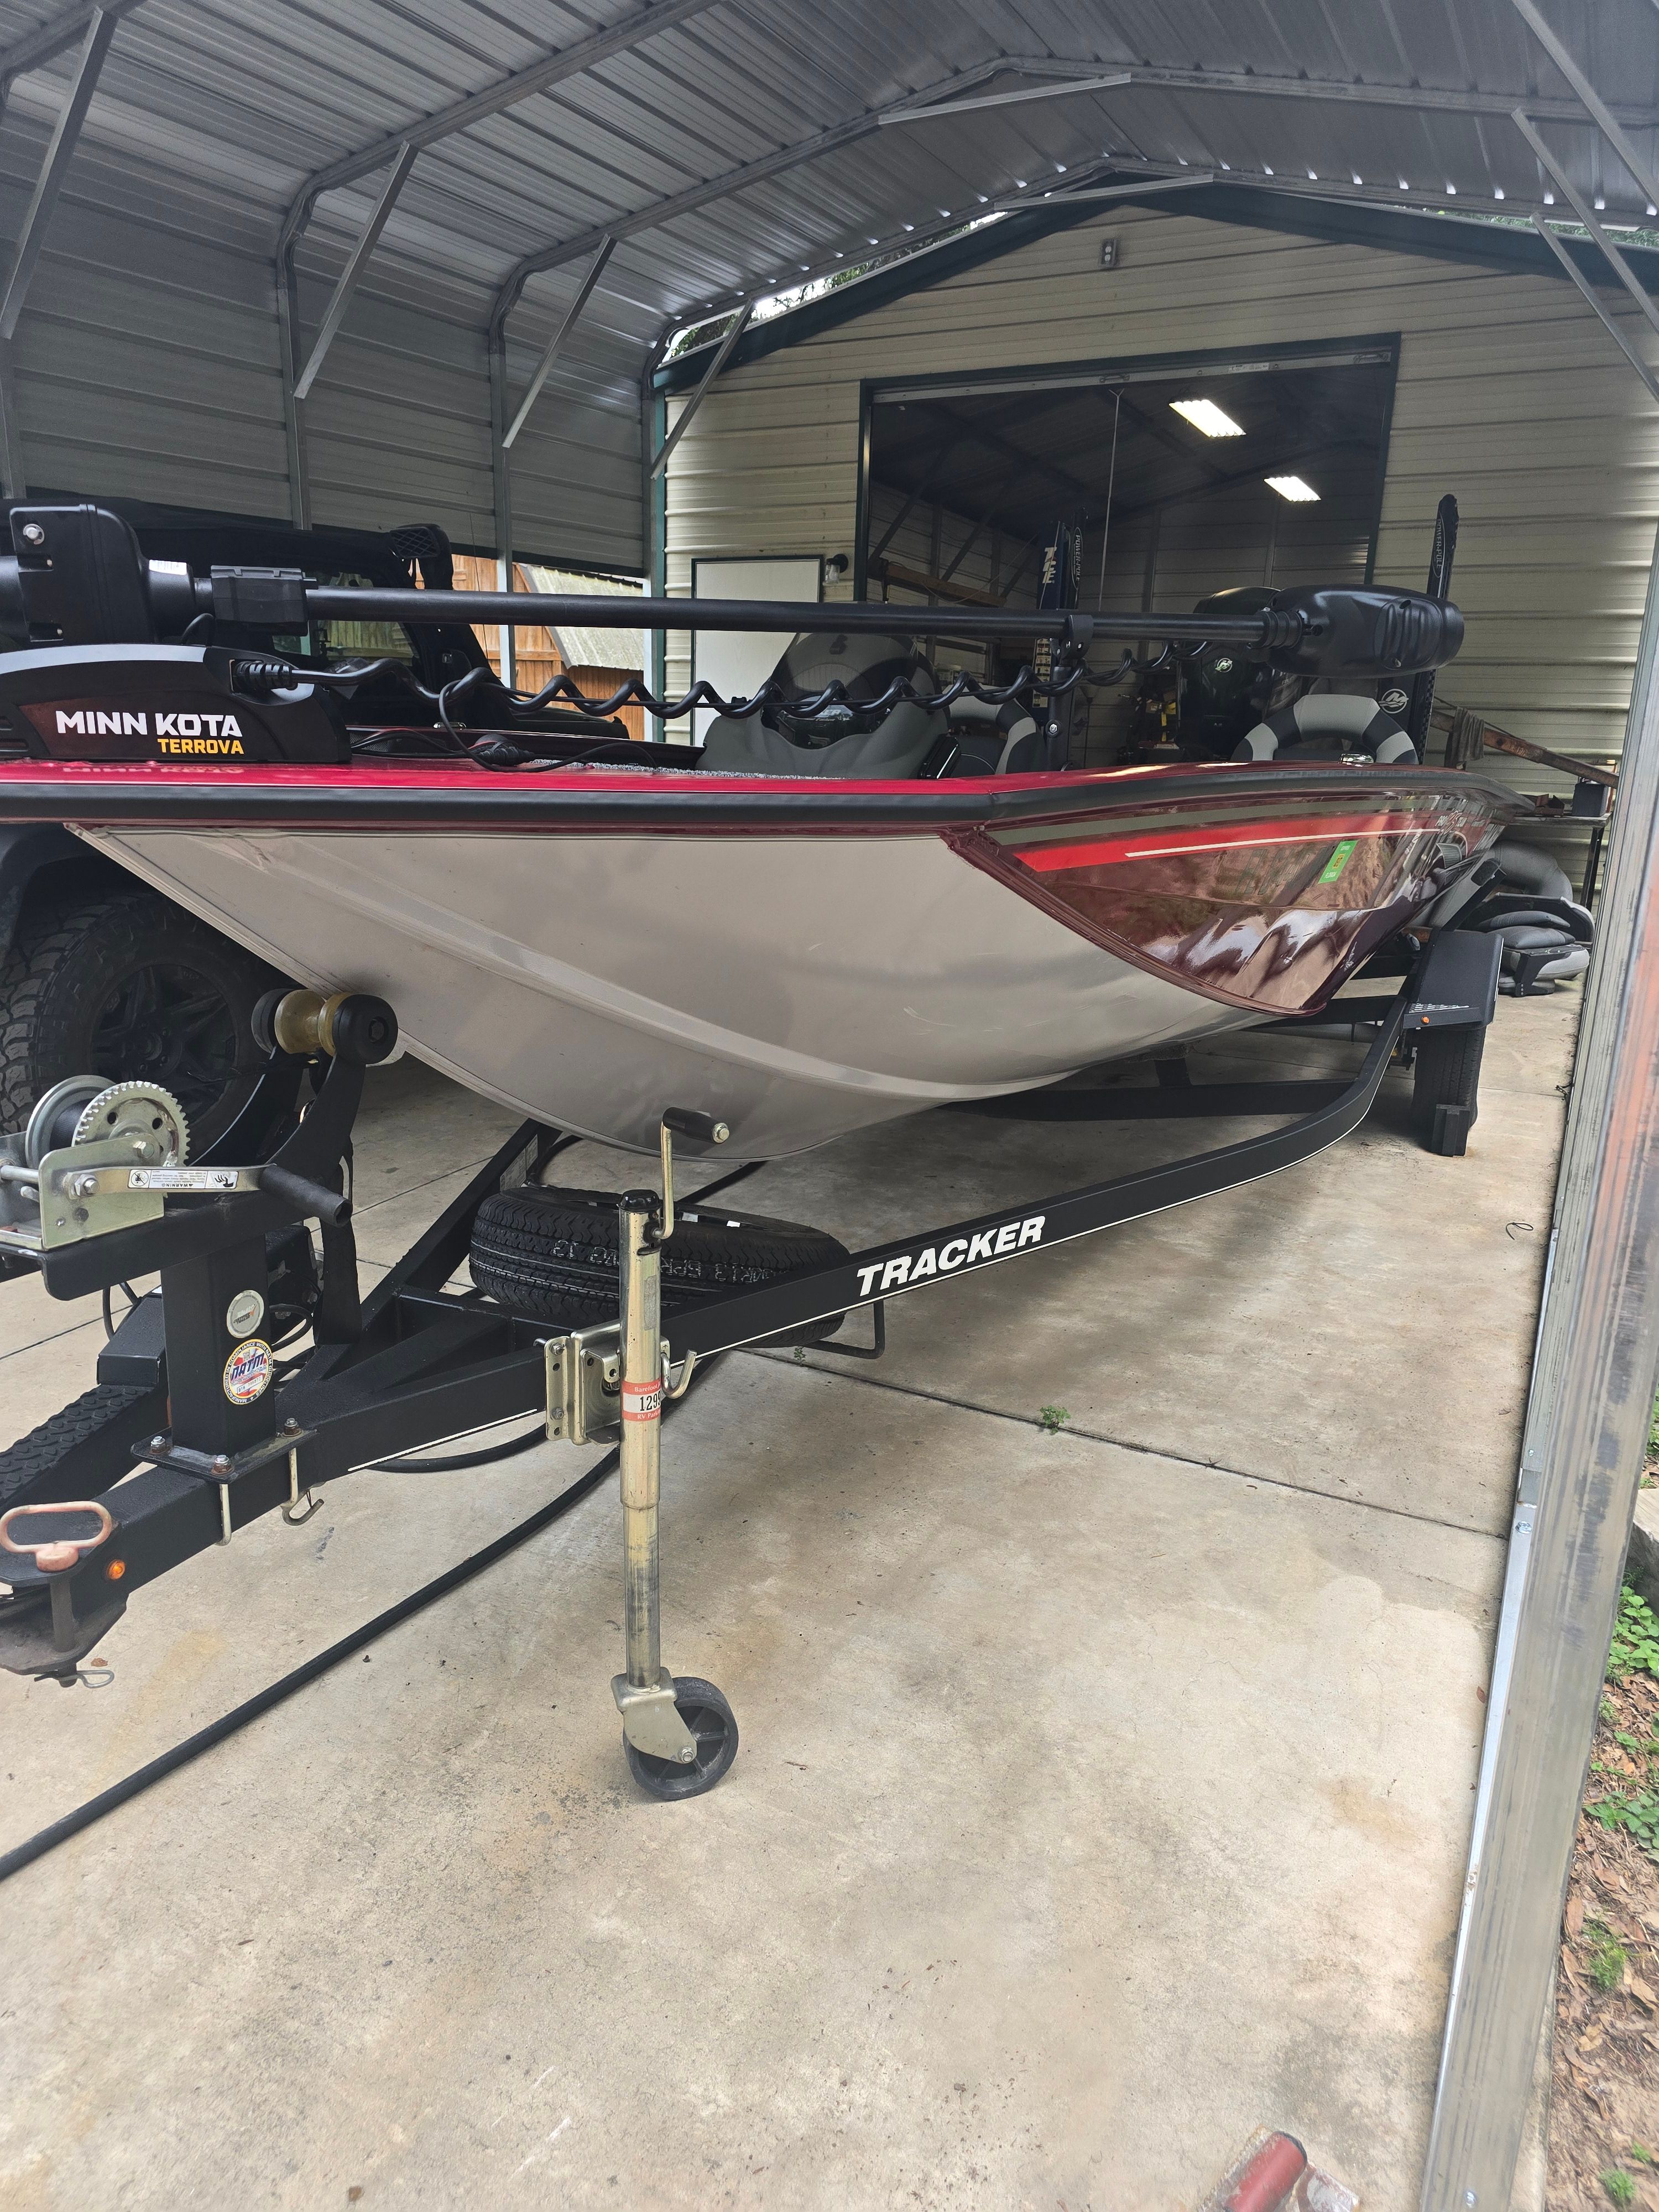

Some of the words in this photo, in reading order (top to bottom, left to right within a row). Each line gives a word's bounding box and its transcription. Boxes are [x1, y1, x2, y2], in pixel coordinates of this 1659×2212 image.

[56, 711, 148, 735] MINN
[155, 713, 243, 737] KOTA
[157, 738, 244, 754] TERROVA
[857, 1215, 1046, 1297] TRACKER
[634, 1384, 658, 1392] Barefoot
